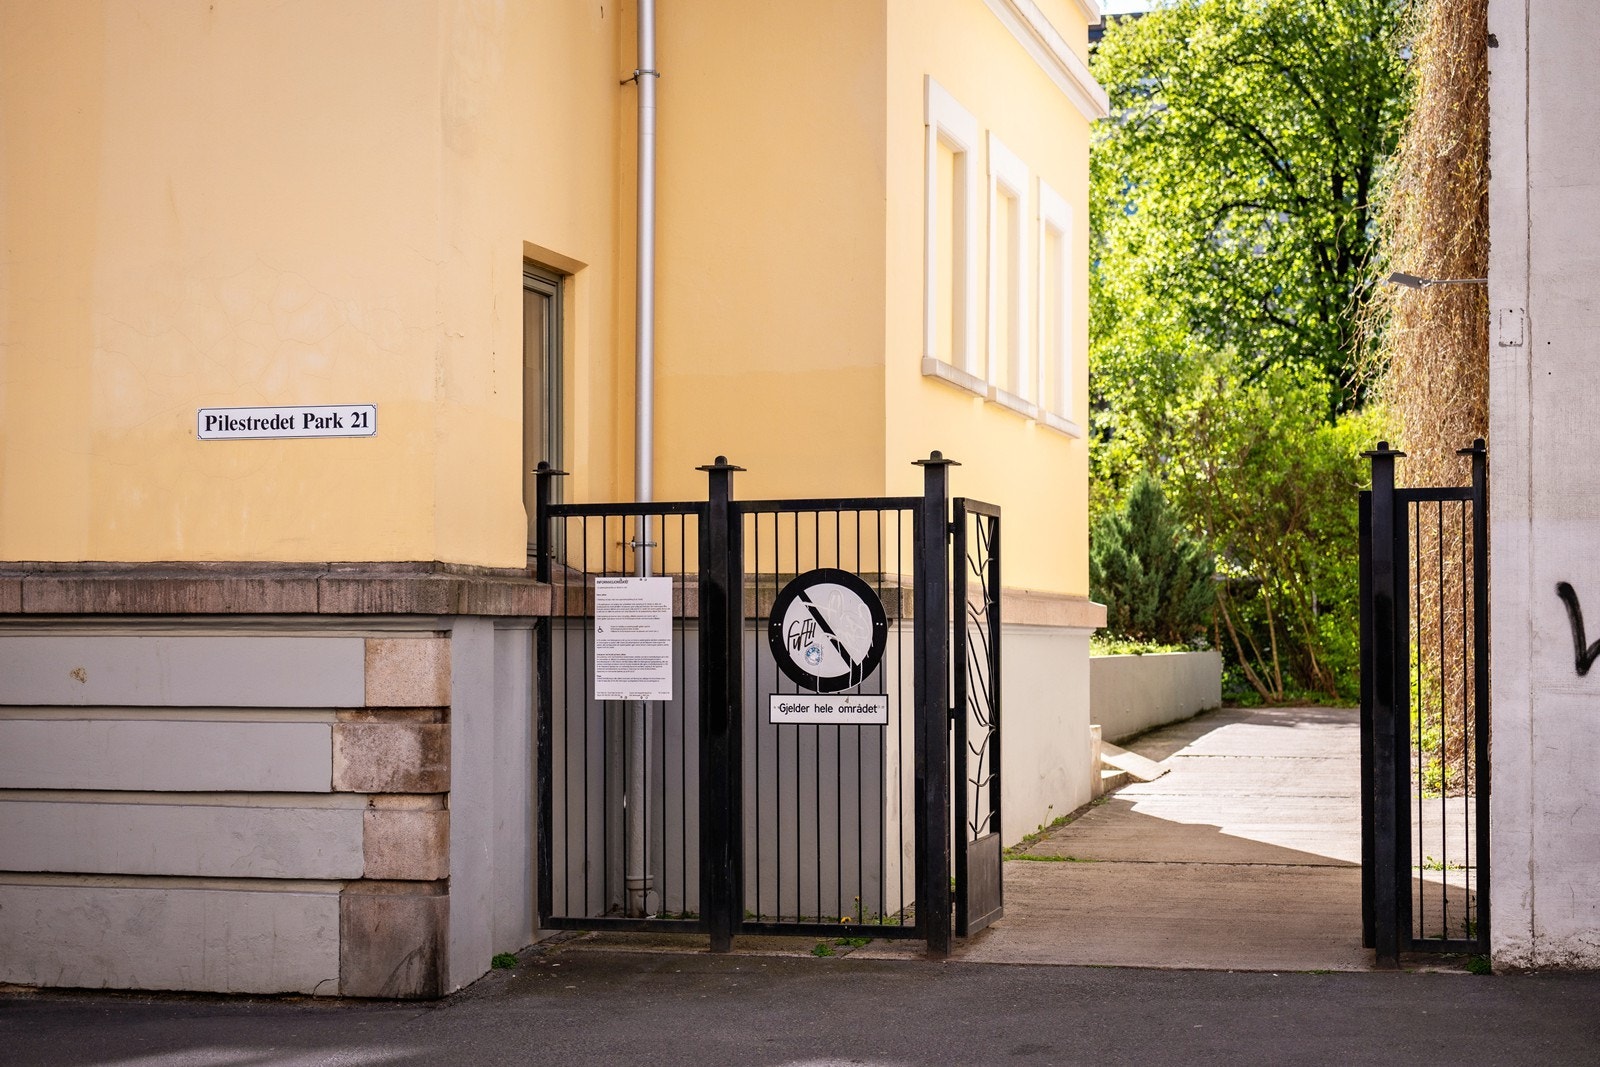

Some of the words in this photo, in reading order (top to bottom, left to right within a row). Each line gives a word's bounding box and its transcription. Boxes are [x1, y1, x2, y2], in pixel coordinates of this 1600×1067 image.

[205, 413, 295, 431] Pilestredet
[302, 412, 343, 429] Park
[350, 411, 369, 428] 21
[779, 703, 810, 715] Gjelder
[814, 703, 833, 714] hele
[838, 703, 878, 714] området
